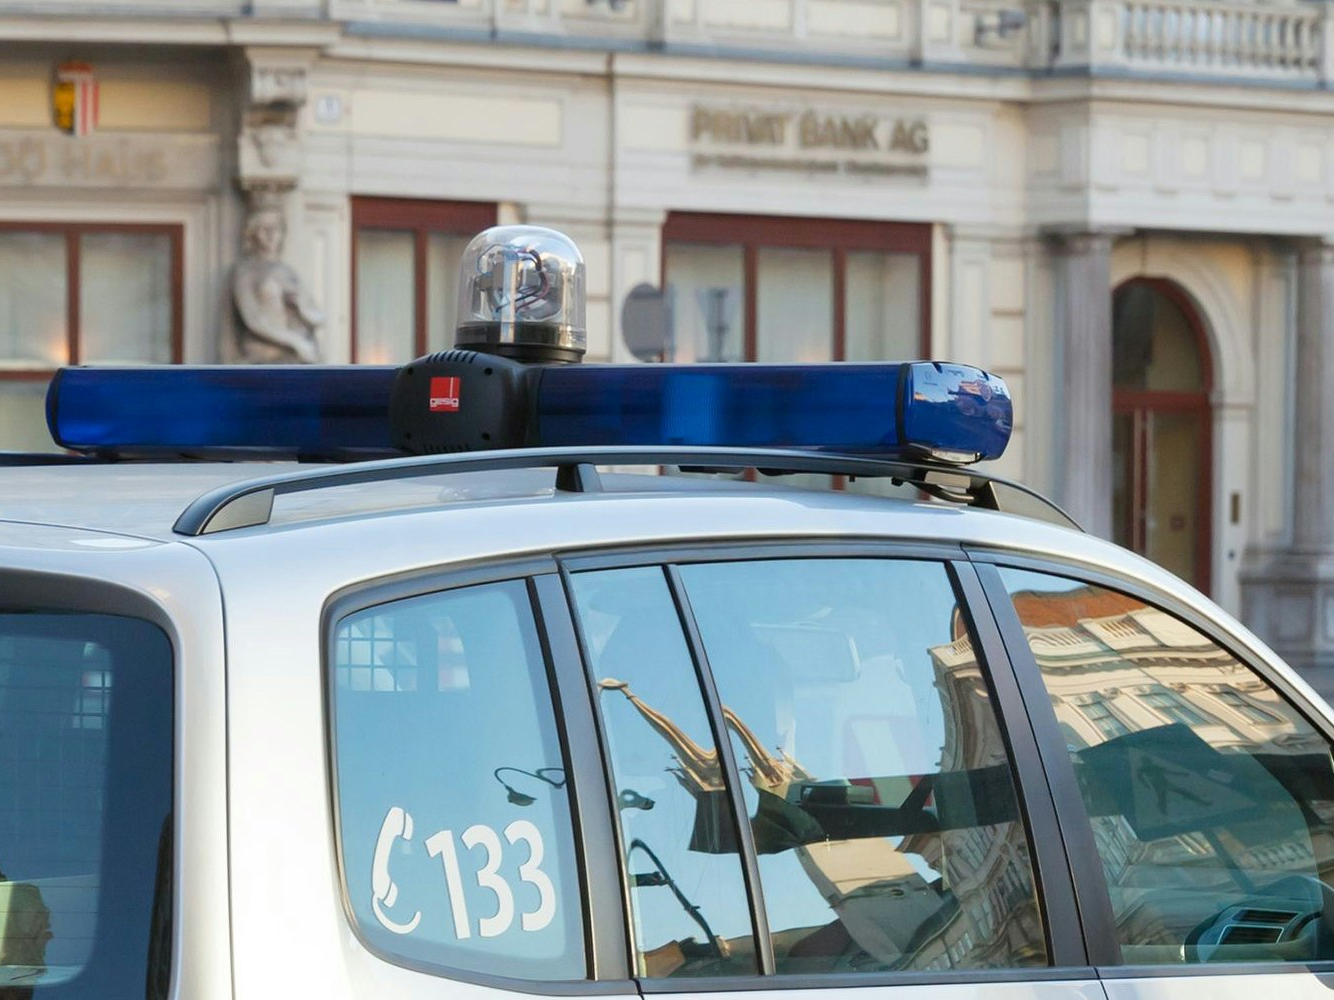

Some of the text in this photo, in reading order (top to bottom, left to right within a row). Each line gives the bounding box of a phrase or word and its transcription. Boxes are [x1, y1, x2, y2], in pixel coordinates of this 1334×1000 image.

[691, 104, 929, 155] PRIVAT BANK AG
[424, 820, 557, 940] 133
